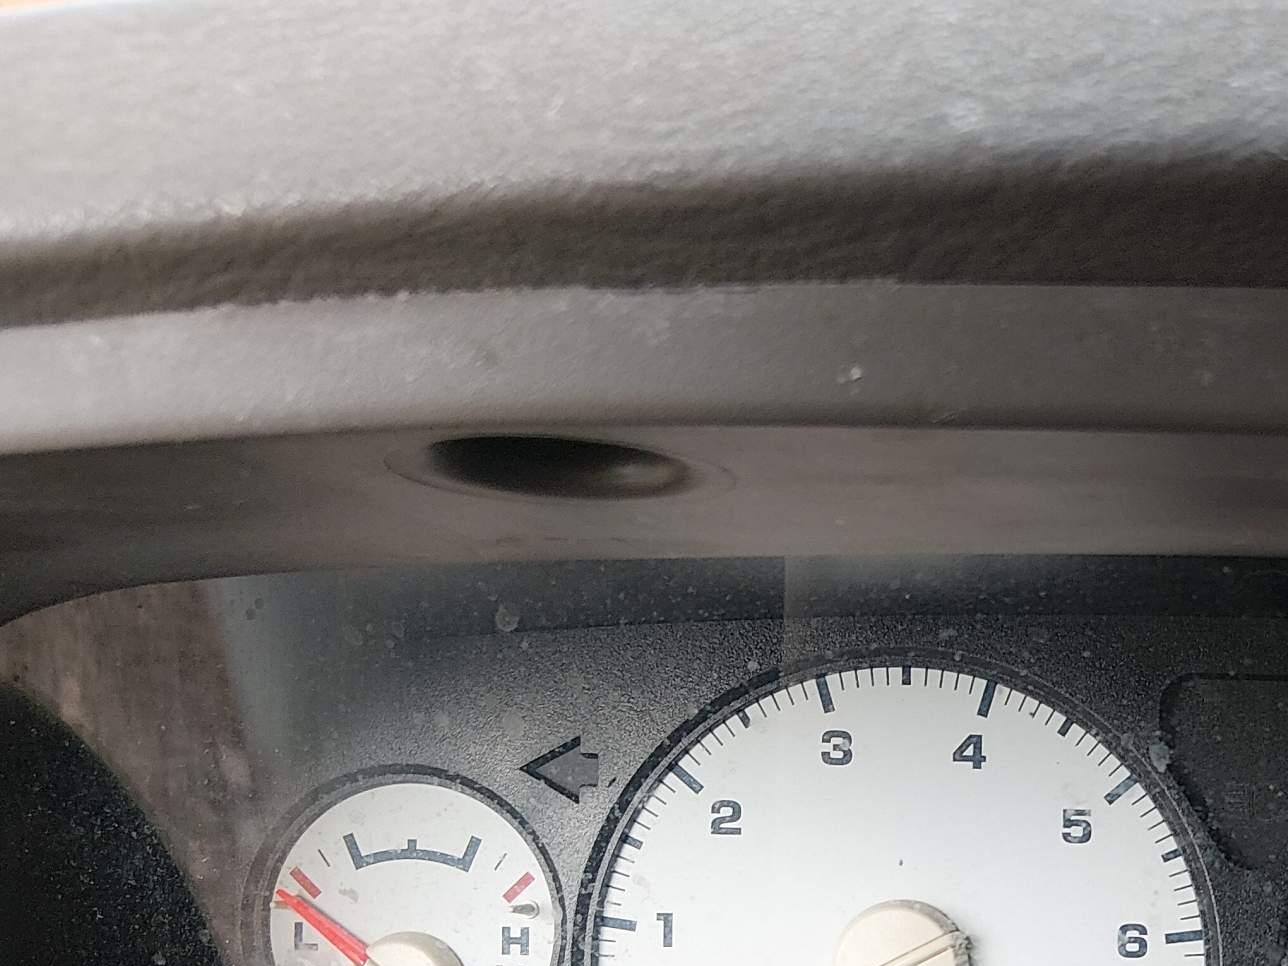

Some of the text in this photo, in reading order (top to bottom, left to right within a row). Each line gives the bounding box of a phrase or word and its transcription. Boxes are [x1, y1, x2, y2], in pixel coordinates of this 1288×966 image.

[821, 730, 853, 765] 3
[952, 734, 986, 769] 4
[710, 800, 742, 835] 2
[1061, 808, 1093, 844] 5
[294, 922, 318, 950] L
[502, 926, 529, 955] H
[655, 912, 674, 947] 1
[1117, 924, 1148, 958] 6
